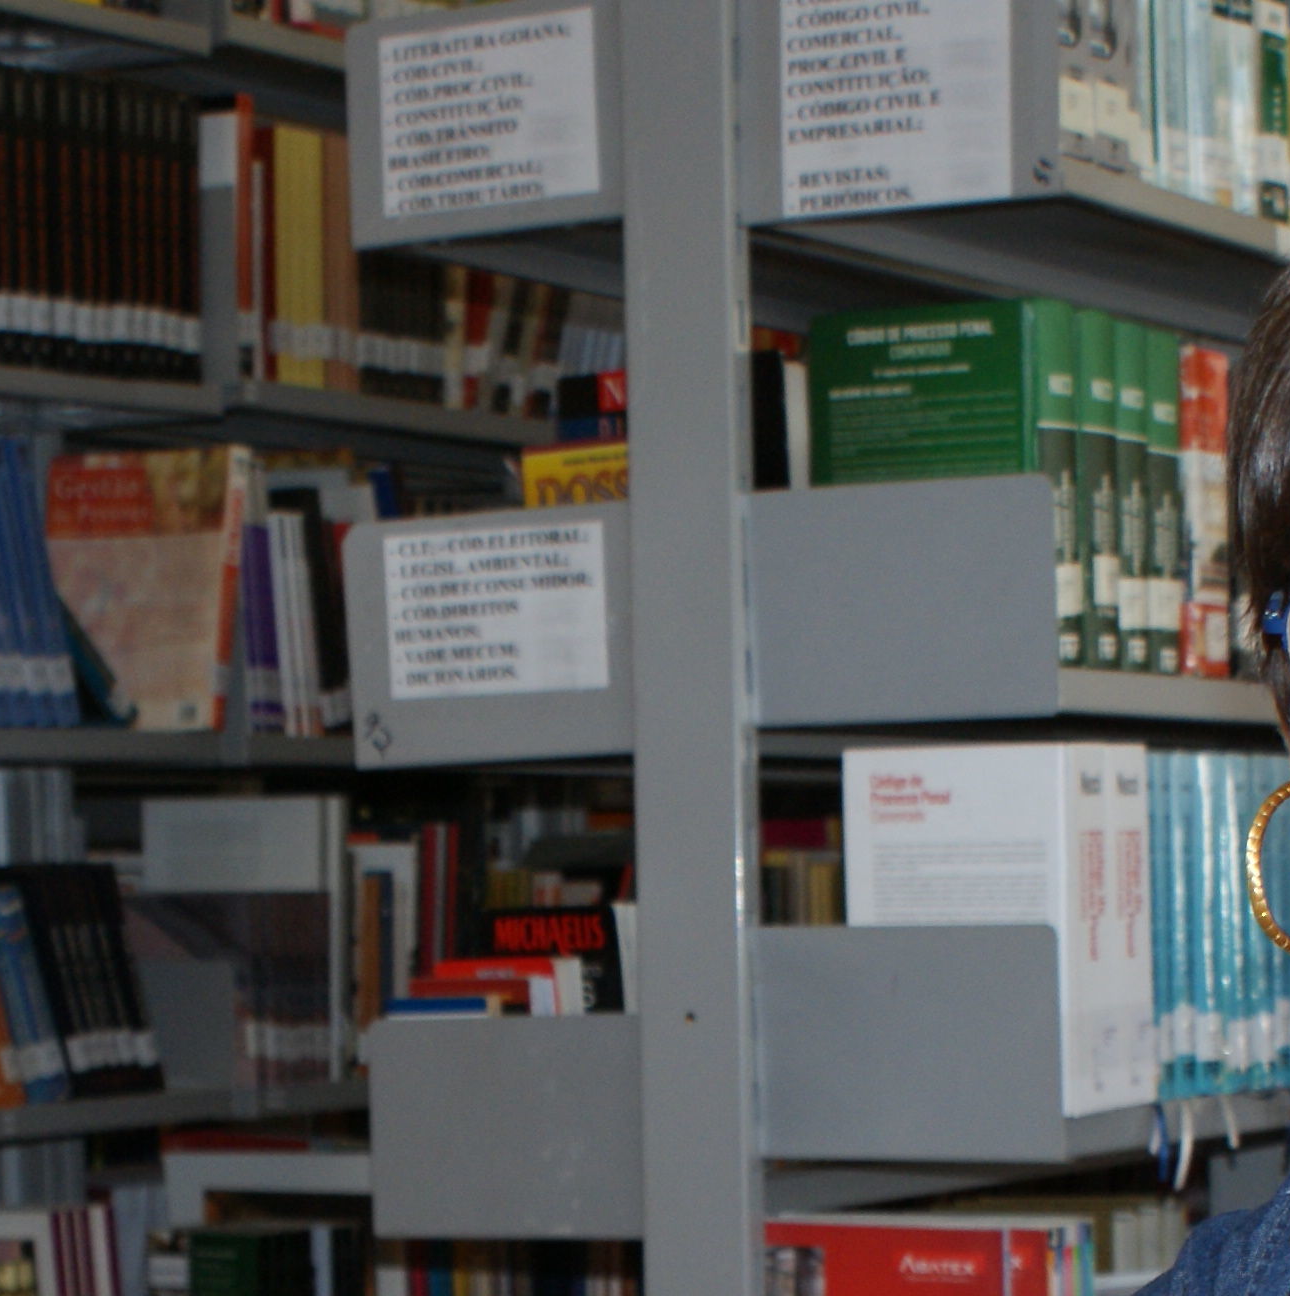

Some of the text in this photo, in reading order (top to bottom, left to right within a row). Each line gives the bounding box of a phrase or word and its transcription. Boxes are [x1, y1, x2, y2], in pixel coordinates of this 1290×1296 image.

[797, 4, 870, 29] CÓDIGO
[894, 48, 907, 63] E
[797, 89, 941, 121] CÓDIGO CIVIL E
[493, 912, 606, 957] MICHAELIS
